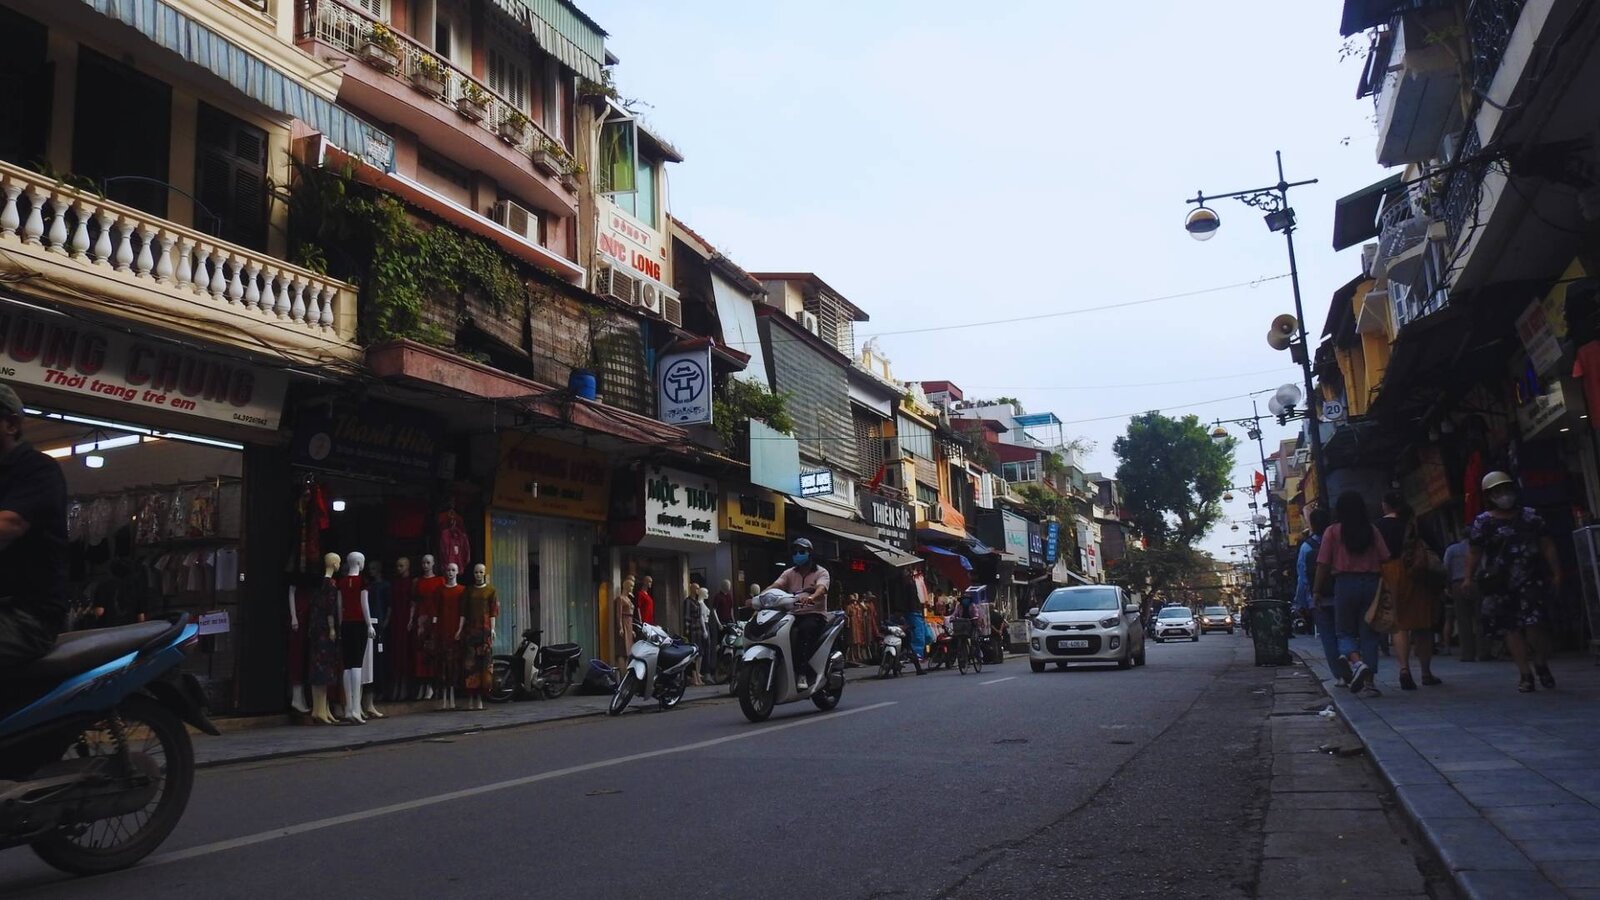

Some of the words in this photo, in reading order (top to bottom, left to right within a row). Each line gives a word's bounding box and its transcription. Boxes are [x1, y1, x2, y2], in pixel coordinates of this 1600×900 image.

[632, 249, 661, 281] LONG
[44, 369, 87, 389] Thời
[90, 379, 137, 401] trang
[143, 390, 168, 404] trẻ
[170, 397, 196, 411] em
[125, 341, 255, 407] CHUNG
[1327, 404, 1341, 415] 20
[648, 475, 680, 509] MỘC
[685, 483, 717, 512] THỦY
[872, 501, 896, 527] THIÊN
[895, 504, 911, 531] SẮC
